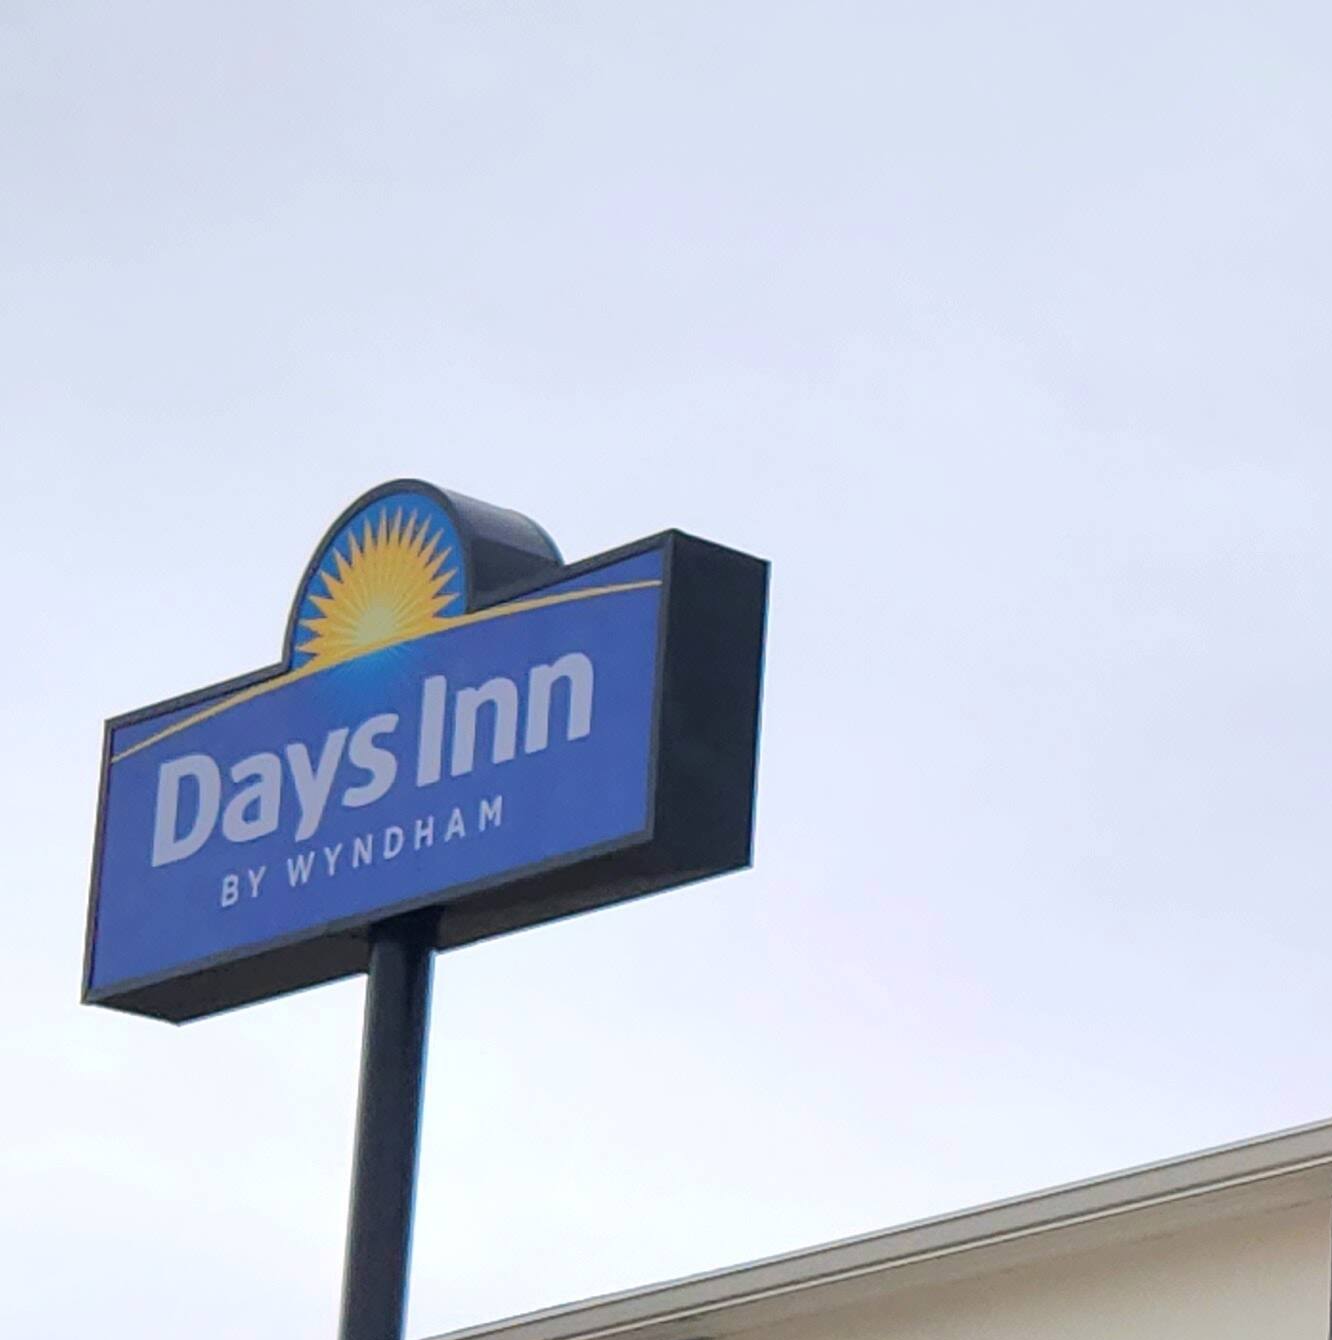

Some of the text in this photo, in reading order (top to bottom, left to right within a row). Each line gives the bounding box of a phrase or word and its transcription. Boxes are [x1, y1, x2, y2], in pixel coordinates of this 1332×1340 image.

[151, 652, 594, 868] Days Inn
[221, 796, 503, 908] BY WYNDHAM
